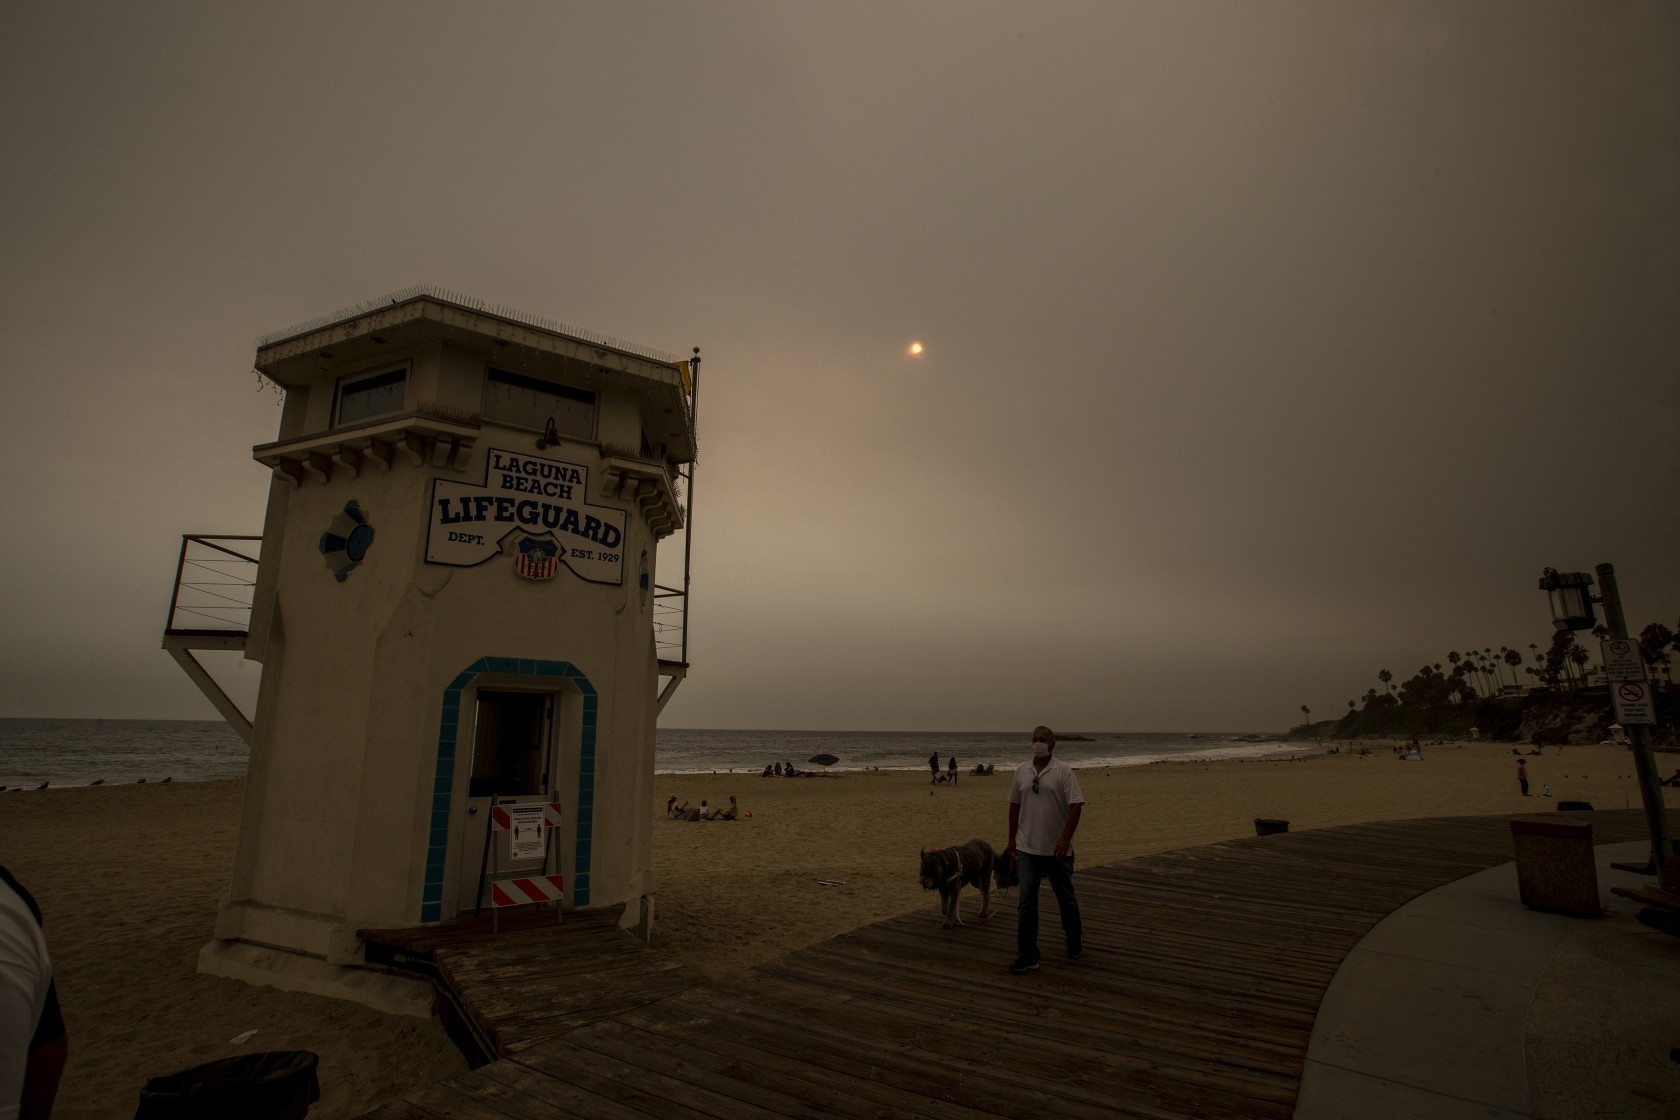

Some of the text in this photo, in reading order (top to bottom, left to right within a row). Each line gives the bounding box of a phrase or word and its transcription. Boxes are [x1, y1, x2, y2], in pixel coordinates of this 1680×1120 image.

[493, 454, 582, 485] LAGUNA
[500, 474, 574, 500] BEACH
[438, 496, 621, 549] LIFEGUARD
[448, 531, 485, 546] DEPT.
[571, 548, 620, 564] EST. 1929
